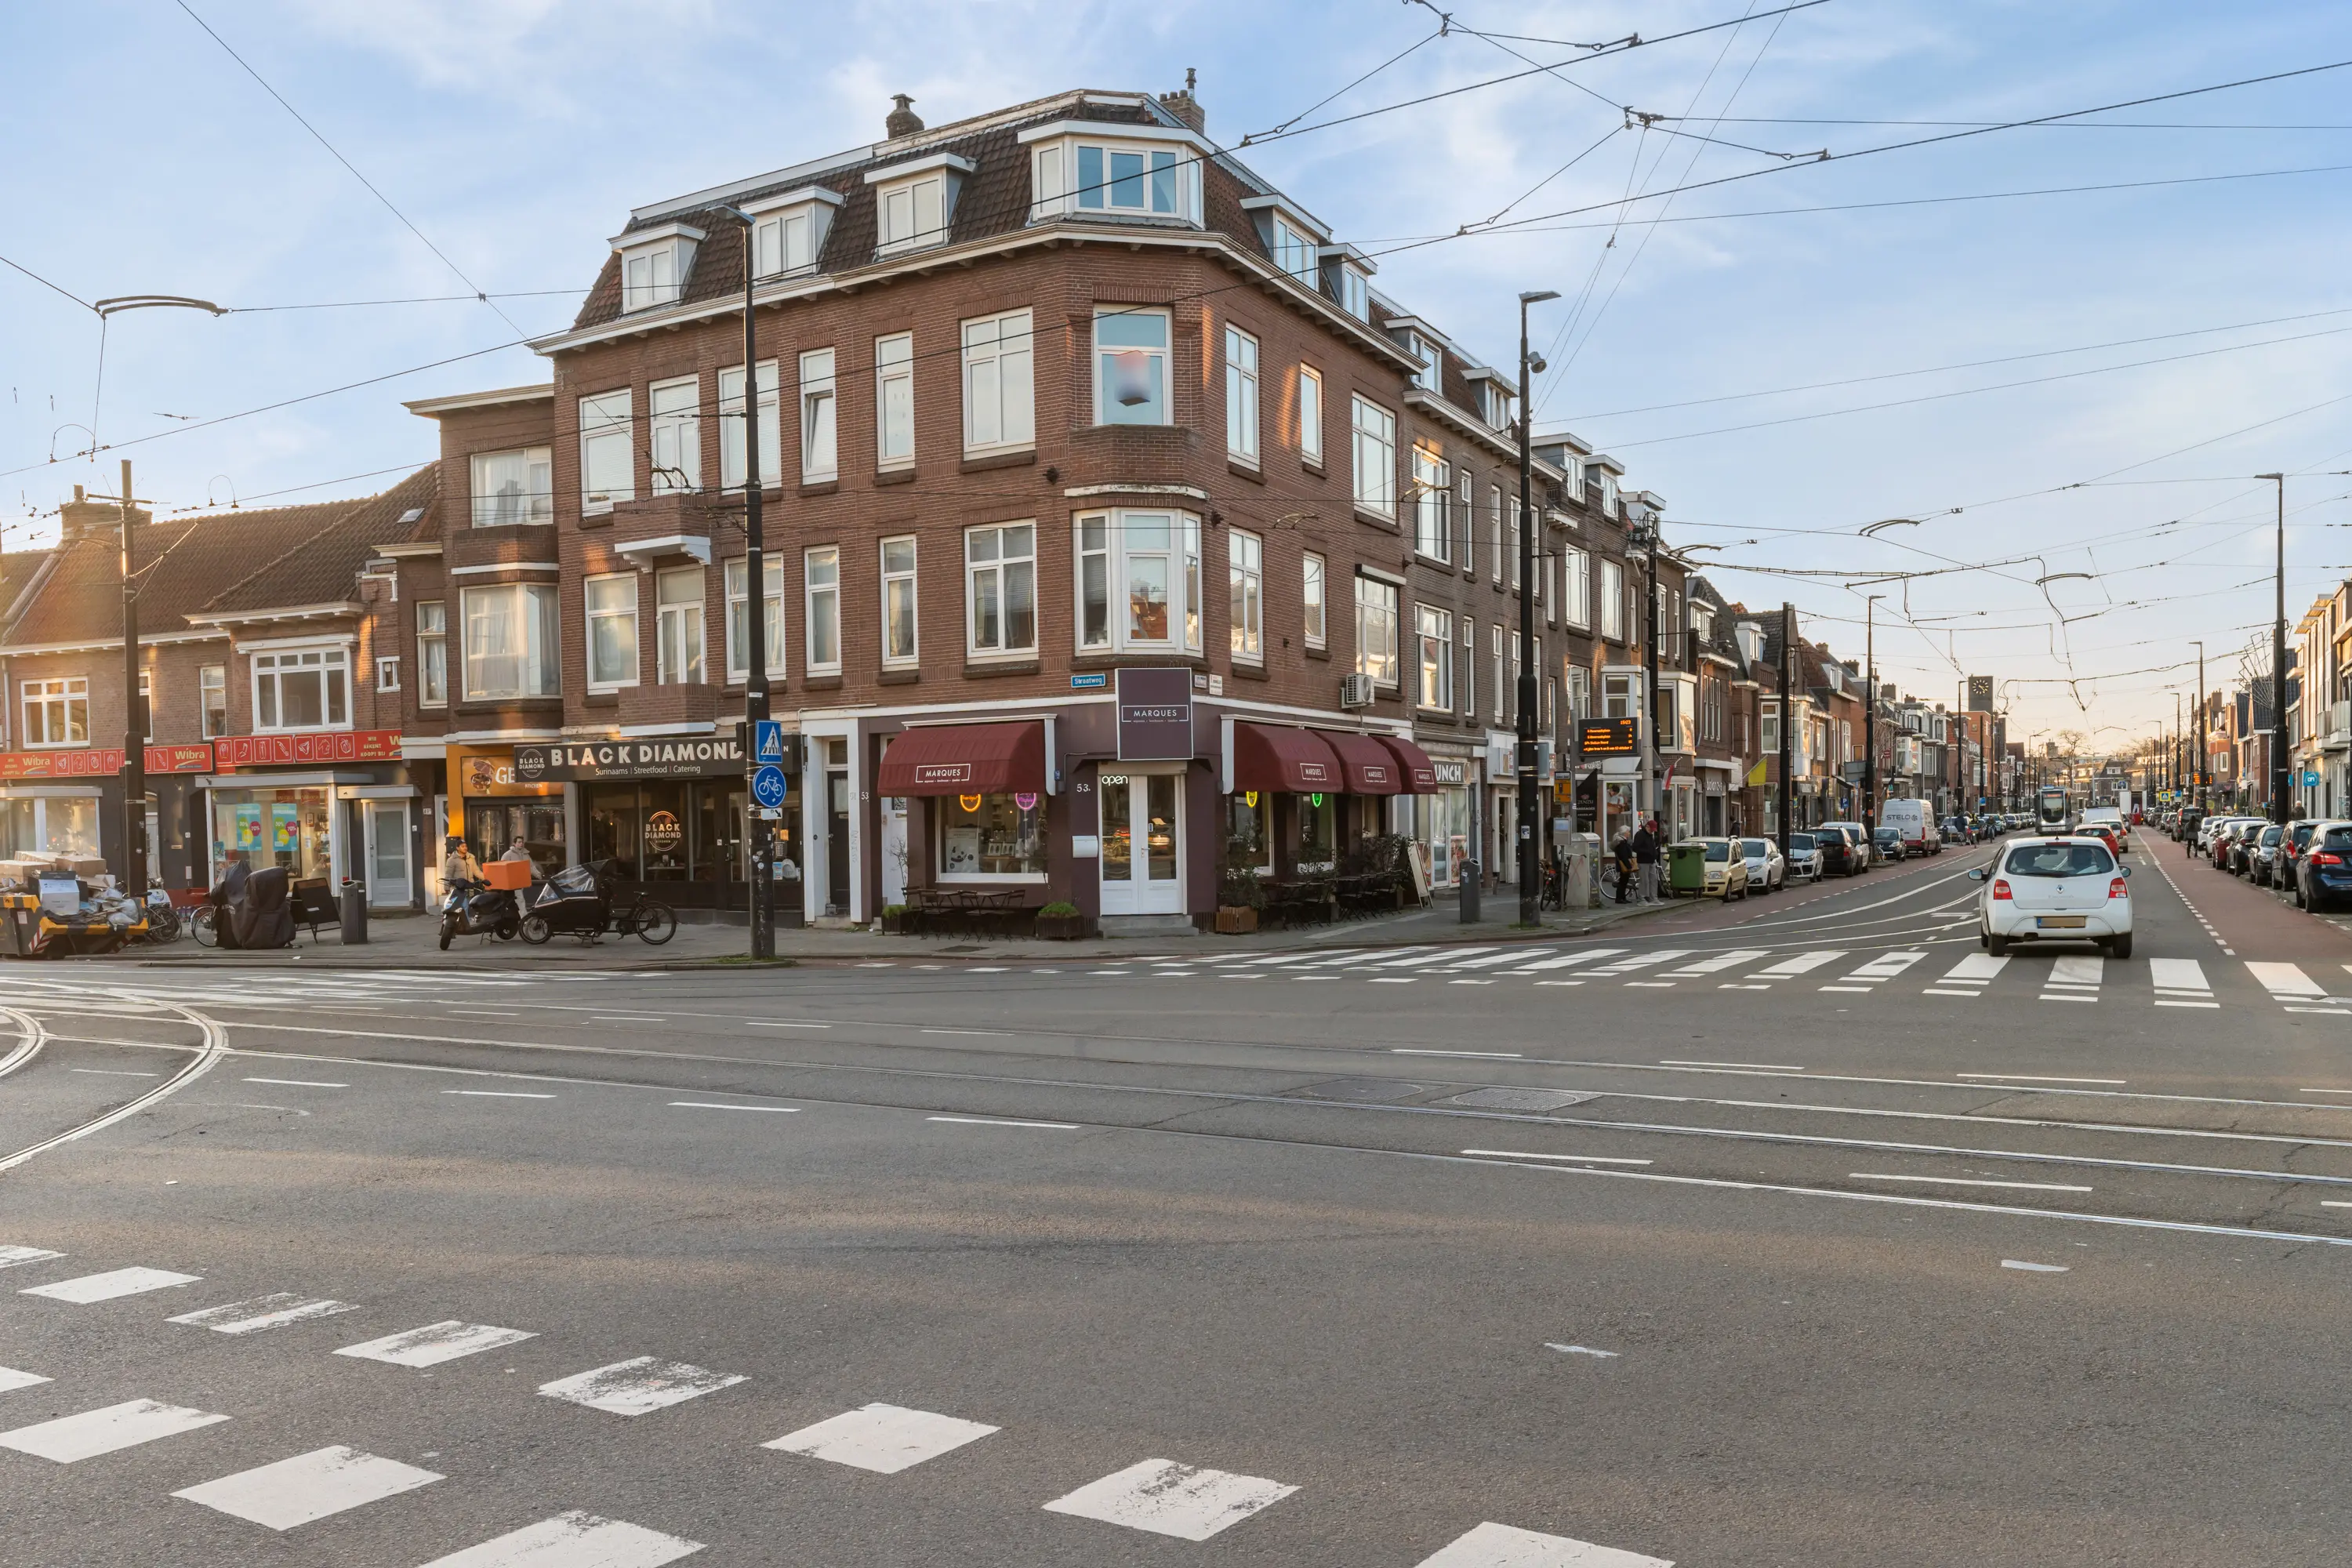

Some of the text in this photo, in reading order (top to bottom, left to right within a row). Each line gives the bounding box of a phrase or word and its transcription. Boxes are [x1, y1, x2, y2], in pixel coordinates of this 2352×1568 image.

[175, 748, 205, 760] Wibra
[551, 742, 744, 766] BLACK DIAMOND
[23, 755, 51, 766] Wibra
[633, 765, 667, 775] Streetfood
[673, 764, 701, 774] Catering
[1434, 764, 1461, 781] UNCH
[1102, 775, 1128, 786] open
